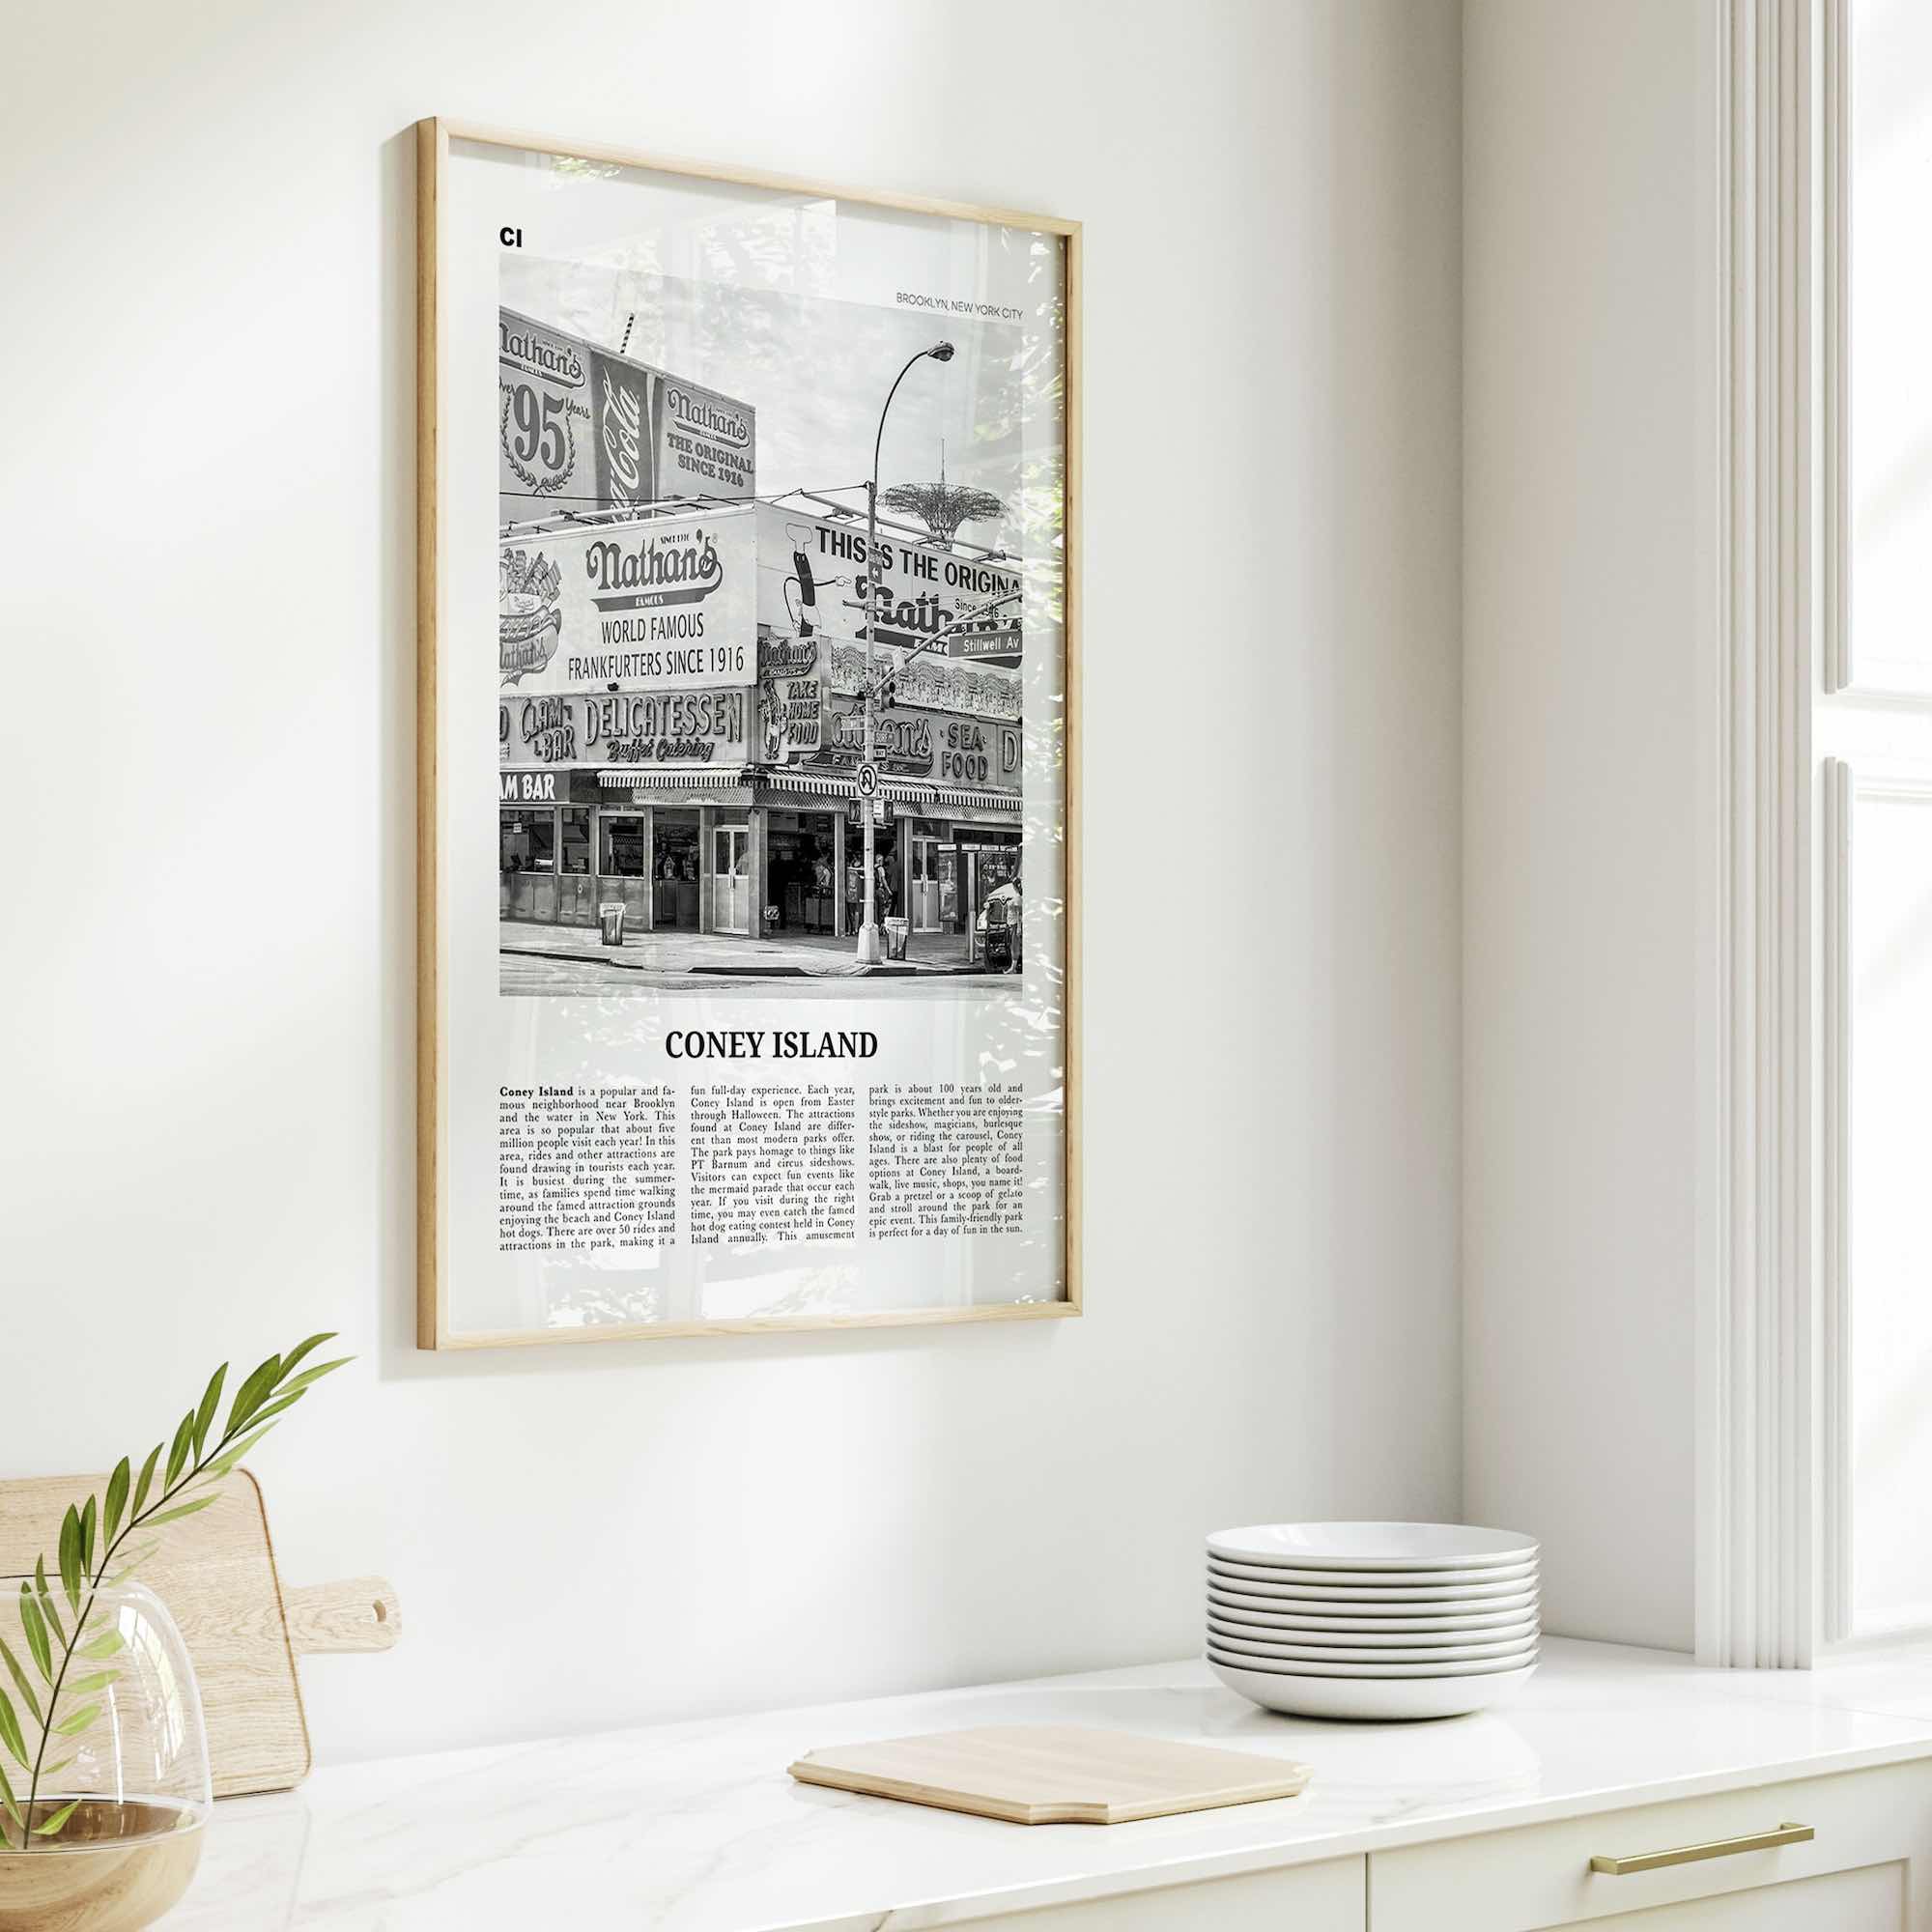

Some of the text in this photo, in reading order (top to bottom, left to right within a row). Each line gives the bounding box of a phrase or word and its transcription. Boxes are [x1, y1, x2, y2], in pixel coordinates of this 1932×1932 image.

[499, 227, 522, 247] CI
[896, 292, 1023, 320] BROOKLYN, NEW YORK CITY
[668, 388, 751, 442] Nathan's
[513, 384, 565, 470] 95
[668, 432, 693, 454] THE
[695, 442, 753, 474] ORIGINAL
[678, 453, 744, 488] SINCE 1916
[586, 528, 723, 590] Nathan's
[815, 526, 867, 563] THIS
[899, 548, 939, 582] THE
[954, 597, 977, 612] Since
[602, 612, 704, 644] WORLD FAMOUS
[963, 636, 1019, 653] Stillwell Av
[568, 646, 744, 681] FRANKFURTERS SINCE 1916
[786, 680, 819, 699] TAKE
[583, 693, 743, 746] DELICATESSEN
[788, 700, 820, 720] HOME
[786, 722, 820, 745] FOOD
[948, 723, 984, 752] SEA
[541, 724, 578, 763] BAR
[941, 751, 989, 781] FOOD
[522, 773, 556, 801] BAR
[666, 1030, 879, 1059] CONEY ISLAND
[499, 1087, 533, 1098] Coney
[539, 1086, 574, 1095] Island
[579, 1086, 585, 1095] is
[600, 1086, 637, 1098] popular
[641, 1086, 659, 1095] and
[663, 1086, 675, 1095] fa-
[691, 1085, 855, 1097] fun full-day experience. Each year,
[869, 1083, 1023, 1095] park is about 100 years old and
[532, 1098, 599, 1111] neighborhood
[635, 1098, 675, 1110] Brooklyn
[691, 1096, 855, 1110] Coney Island is open from Easter
[869, 1094, 1022, 1108] brings excitement and fun to older-
[499, 1110, 675, 1122] and the water in New York. This
[691, 1108, 855, 1122] through Halloween. The attractions
[869, 1107, 889, 1120] style
[891, 1107, 916, 1120] parks.
[919, 1107, 954, 1117] Whether
[956, 1109, 971, 1119] you
[988, 1106, 1023, 1119] enjoying
[527, 1124, 535, 1134] is
[557, 1123, 595, 1136] popular
[601, 1123, 620, 1133] that
[626, 1123, 654, 1133] about
[659, 1122, 675, 1133] five
[691, 1122, 718, 1132] found
[724, 1122, 732, 1132] at
[739, 1122, 767, 1134] Coney
[775, 1122, 801, 1131] Island
[828, 1121, 854, 1130] differ-
[869, 1118, 1023, 1131] the sideshow, magicians, burlesque
[500, 1135, 675, 1150] million people visit each year! In this
[691, 1132, 854, 1146] ent than most modern parks offer.
[869, 1131, 893, 1143] show,
[910, 1130, 935, 1143] riding
[940, 1130, 952, 1140] the
[956, 1130, 993, 1141] carousel,
[997, 1129, 1023, 1142] Coney
[693, 1145, 854, 1159] The park pays homage to things like
